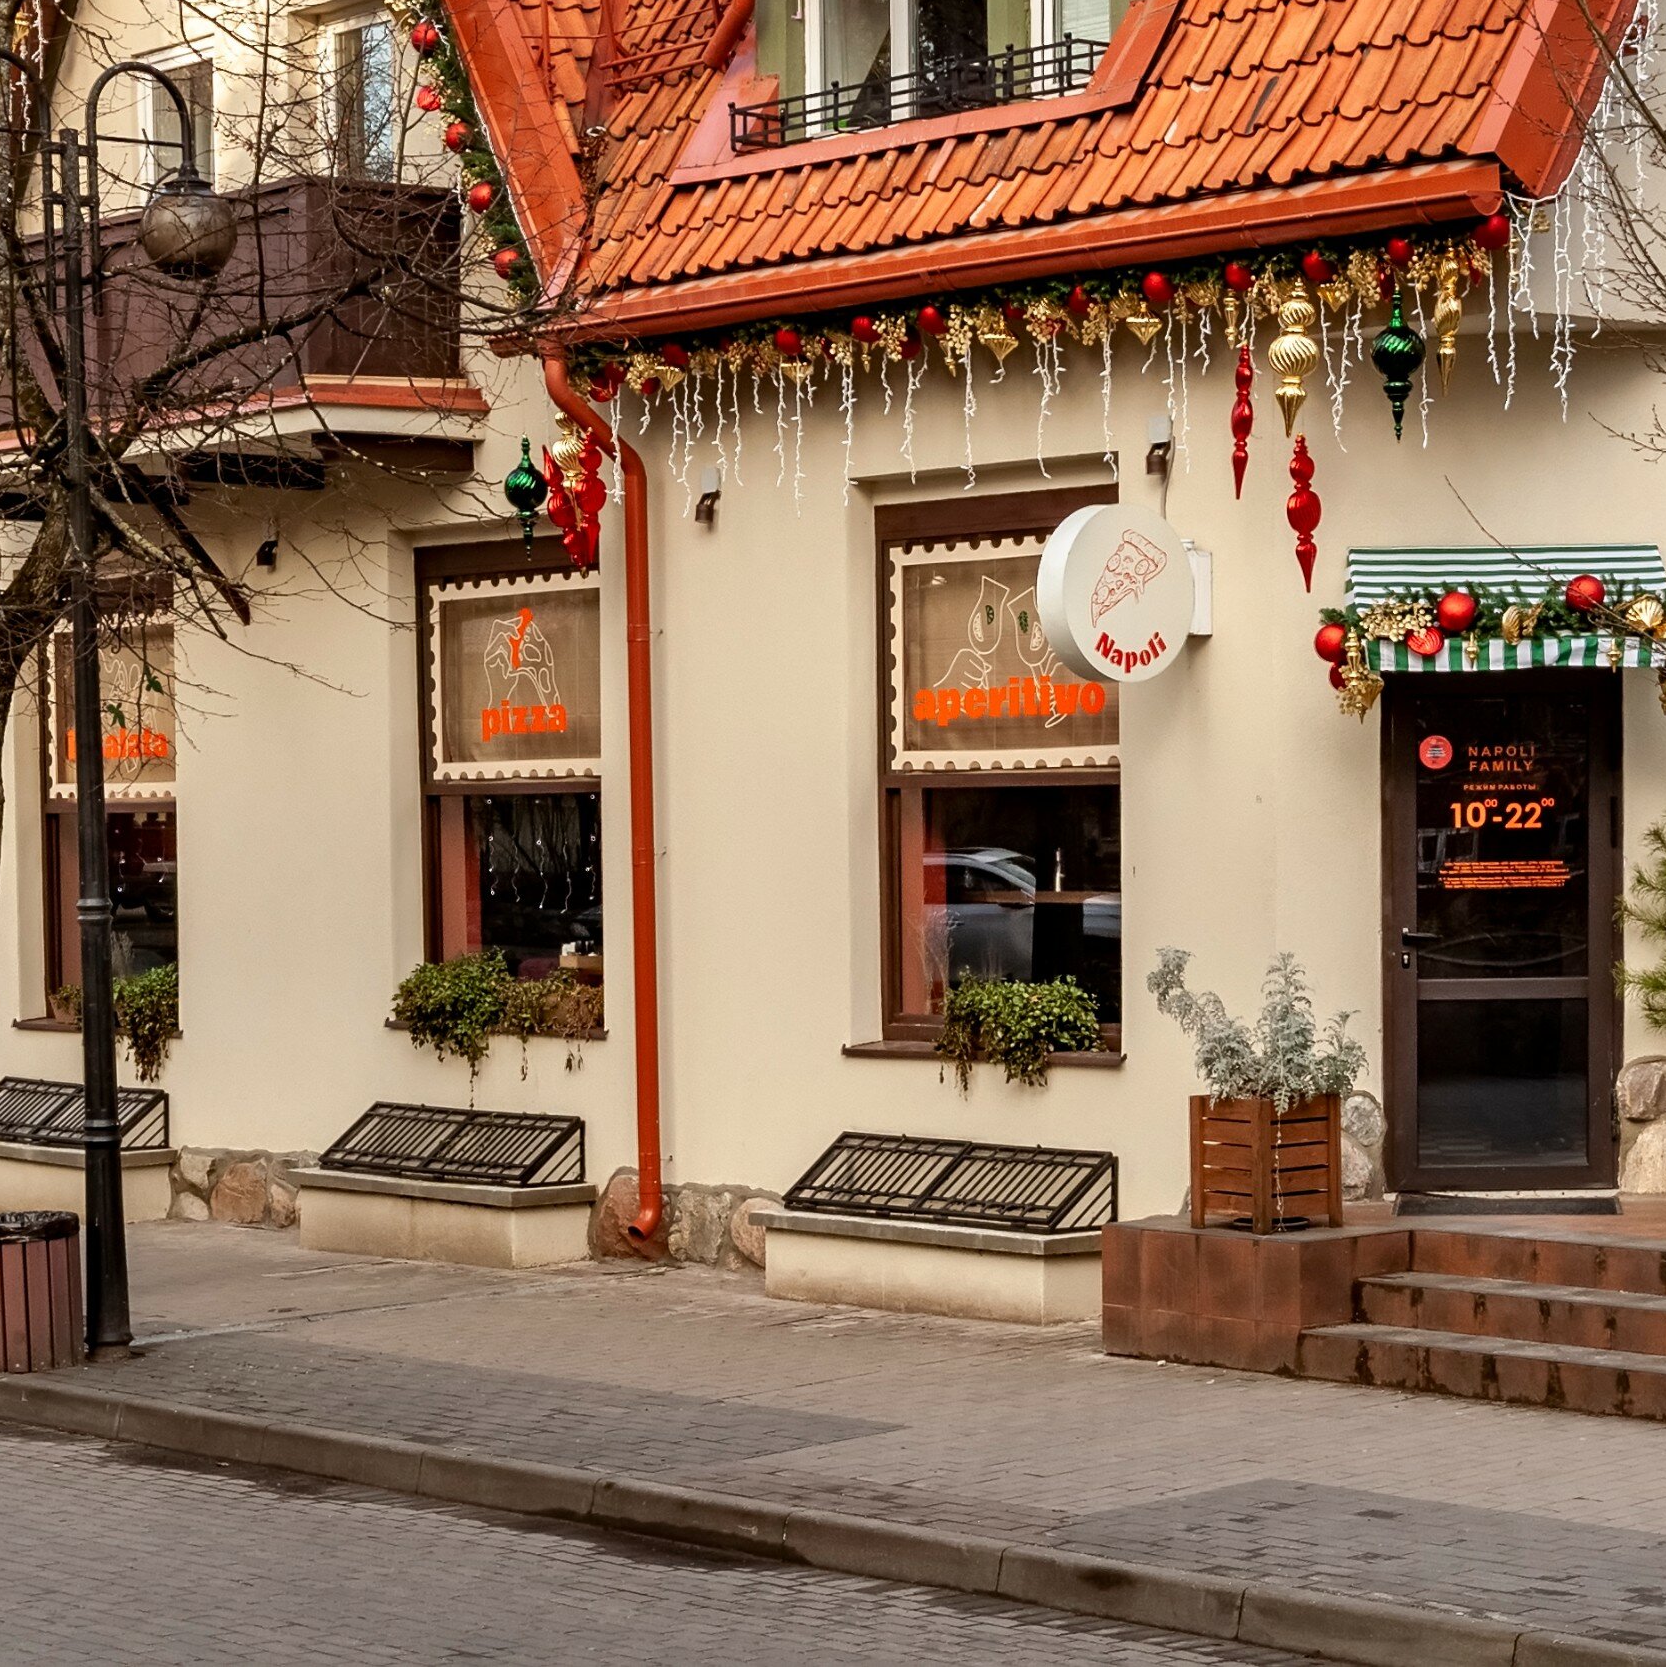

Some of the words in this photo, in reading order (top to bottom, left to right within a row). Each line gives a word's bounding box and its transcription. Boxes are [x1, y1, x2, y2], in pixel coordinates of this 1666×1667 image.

[1095, 631, 1167, 674] Napoli
[913, 675, 1106, 727] aperitivo
[481, 699, 567, 743] pizza
[67, 727, 169, 763] ialata
[1468, 745, 1535, 757] NAPOLI
[1469, 760, 1534, 772] FAMILY
